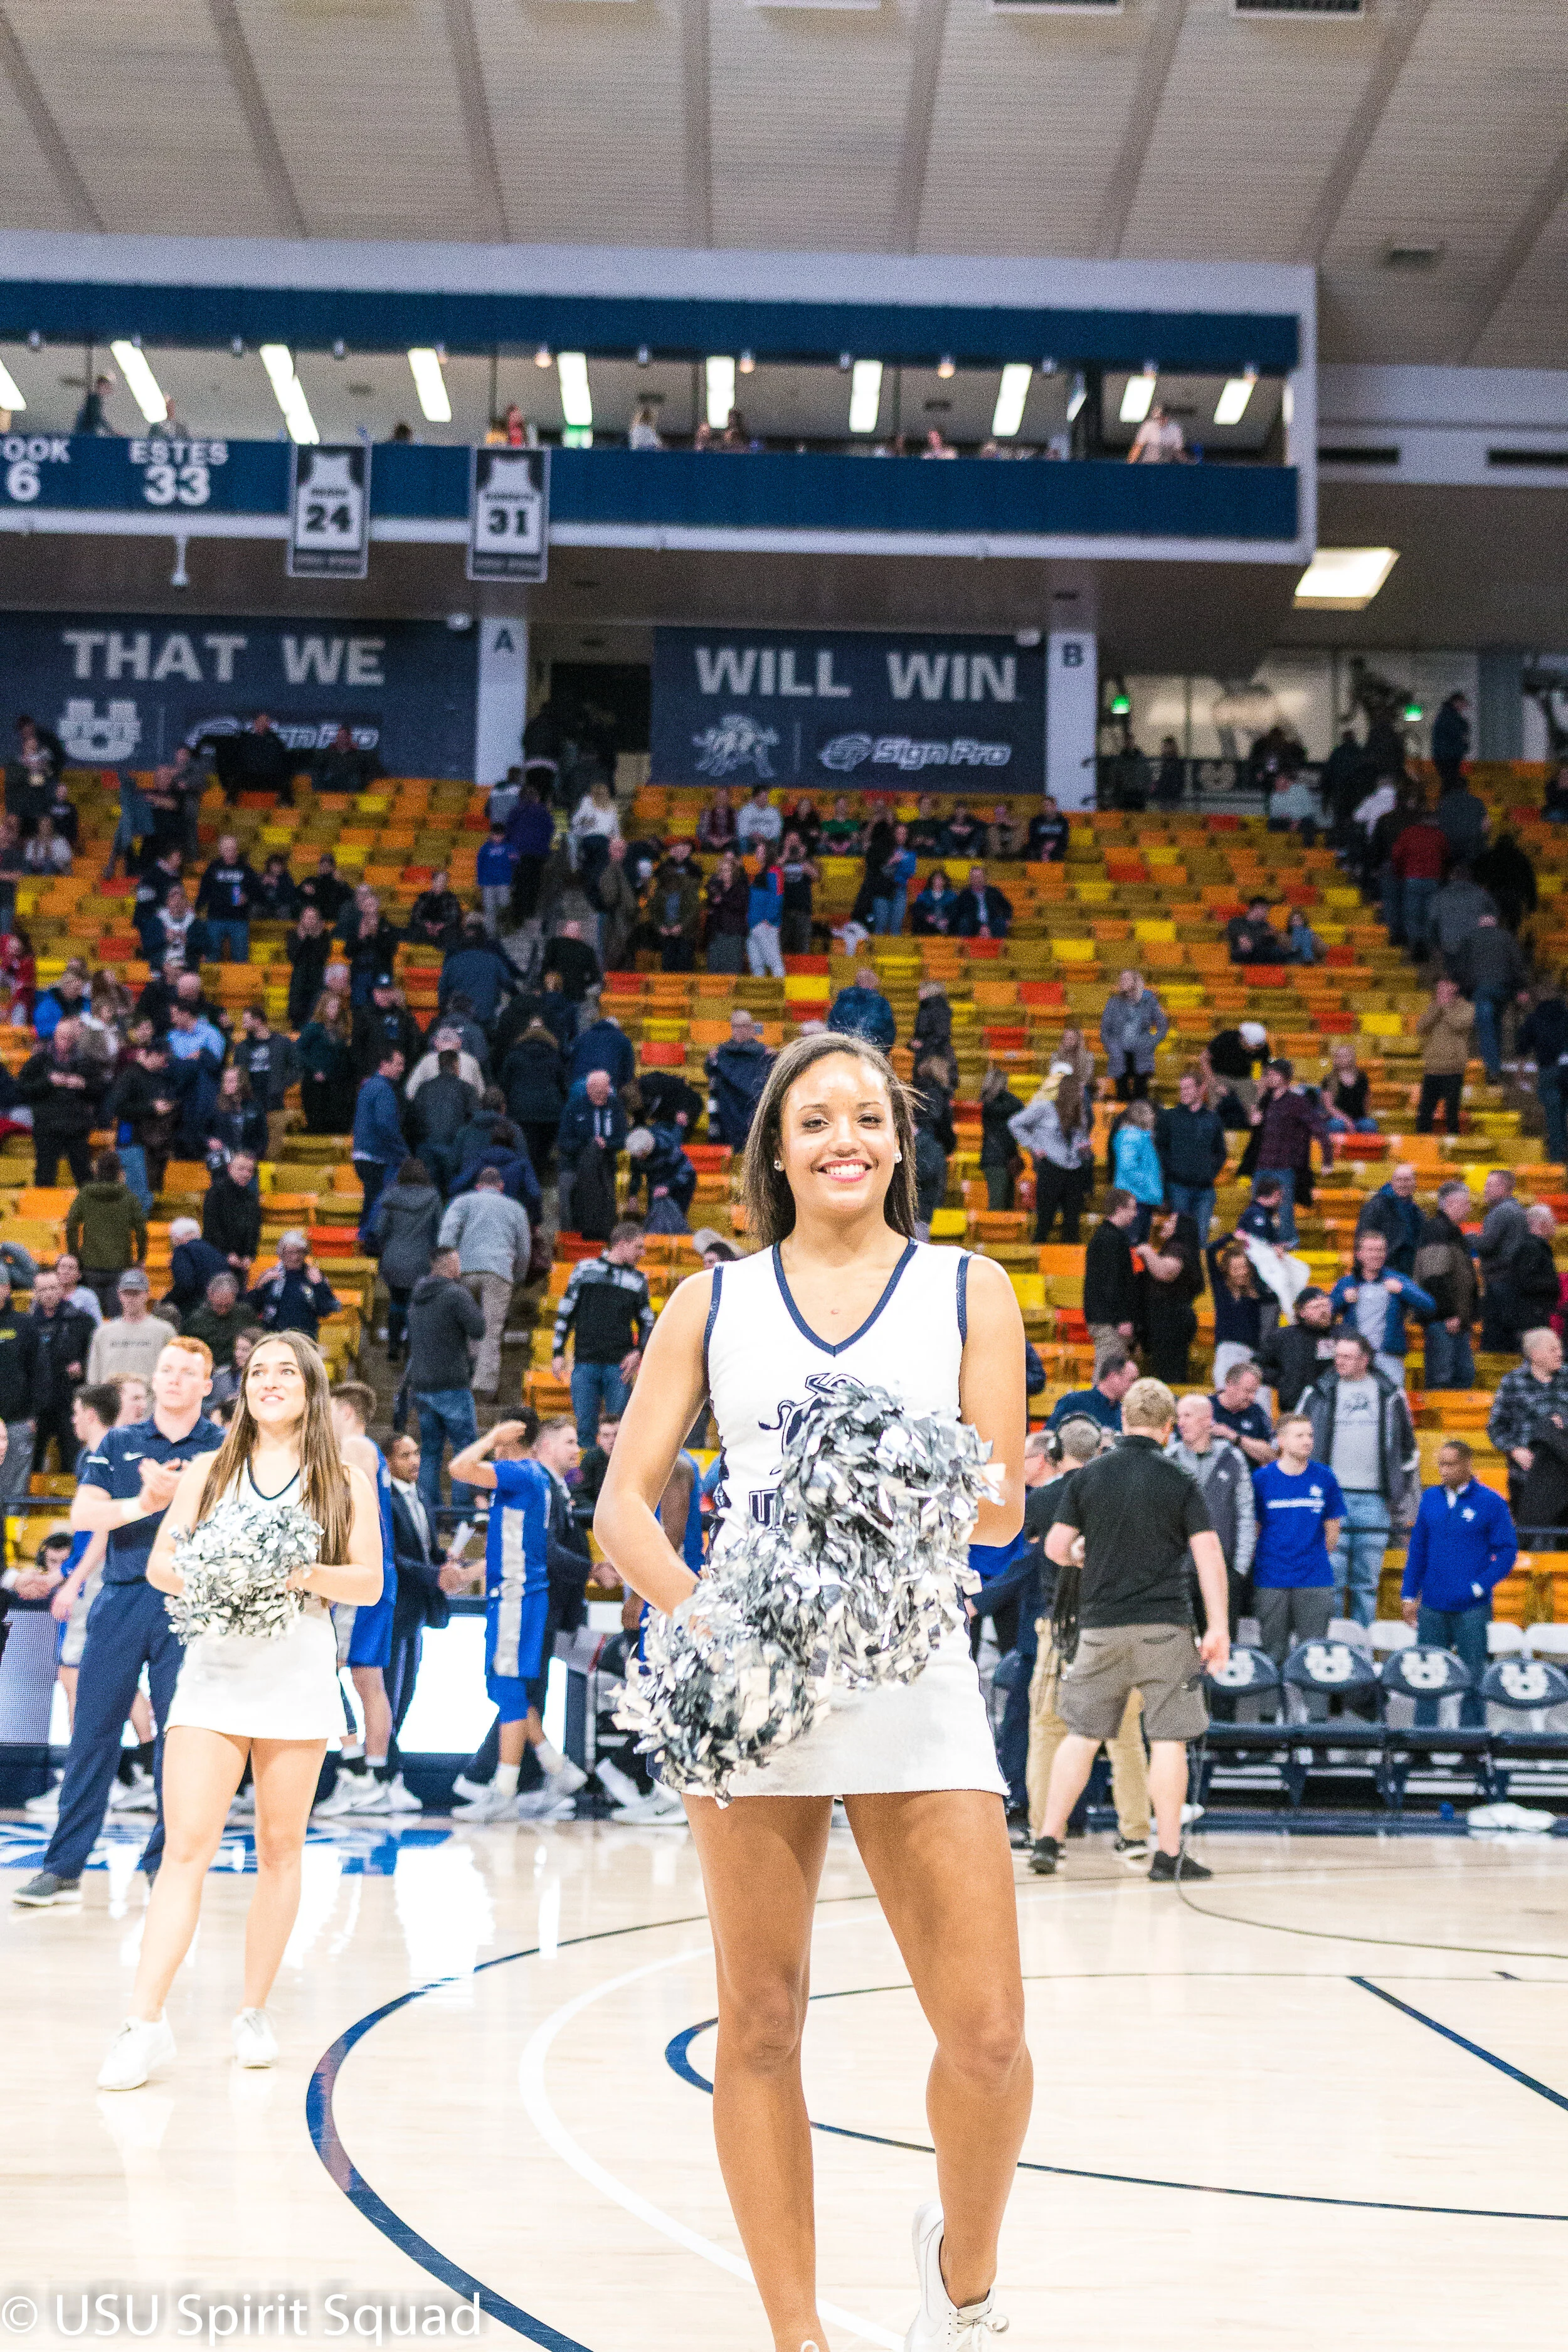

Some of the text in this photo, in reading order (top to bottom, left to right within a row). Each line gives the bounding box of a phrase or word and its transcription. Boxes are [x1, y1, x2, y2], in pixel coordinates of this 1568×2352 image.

[0, 437, 70, 463] OOK
[129, 438, 228, 465] ESTES
[6, 460, 40, 502] 6
[144, 464, 211, 506] 33
[305, 503, 352, 533] 24
[488, 507, 528, 536] 31
[493, 627, 516, 653] A
[1061, 641, 1084, 668] B
[63, 631, 385, 686] THAT WE
[695, 647, 1017, 702] WILL WIN
